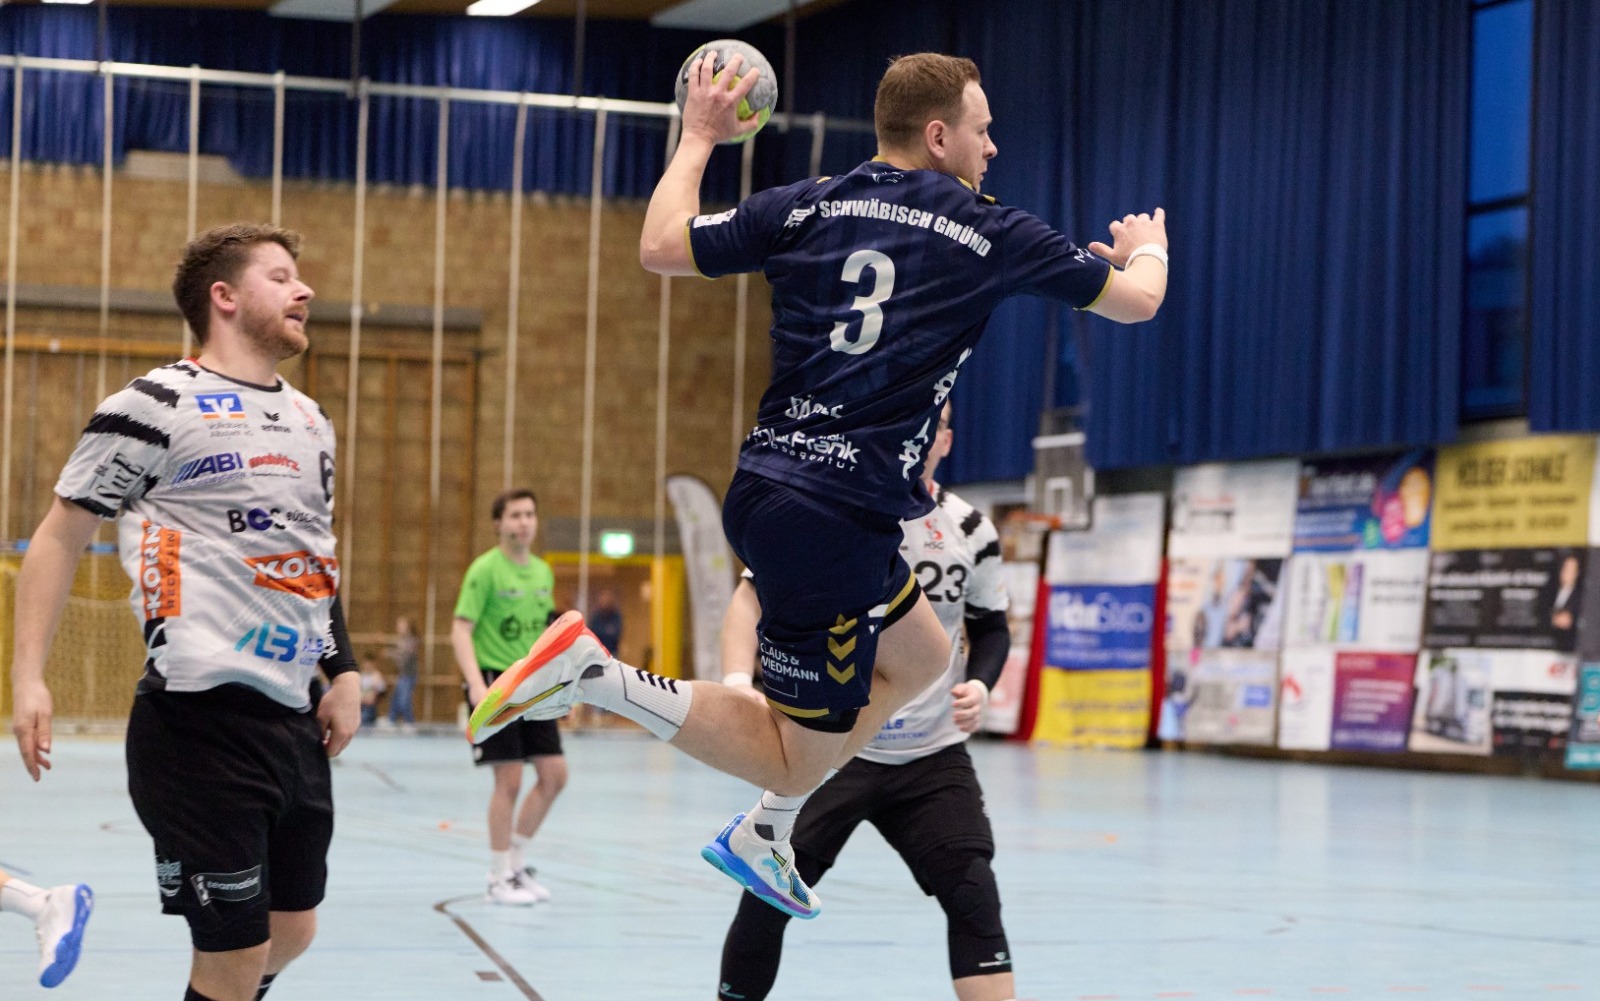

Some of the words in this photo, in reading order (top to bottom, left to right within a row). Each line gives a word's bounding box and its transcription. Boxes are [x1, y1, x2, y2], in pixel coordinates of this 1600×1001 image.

[819, 199, 934, 229] SCHWÄBISCH
[933, 215, 993, 258] GMÜND
[829, 249, 896, 355] 3
[143, 525, 162, 612] KORN
[914, 560, 967, 603] 23
[790, 655, 800, 666] &
